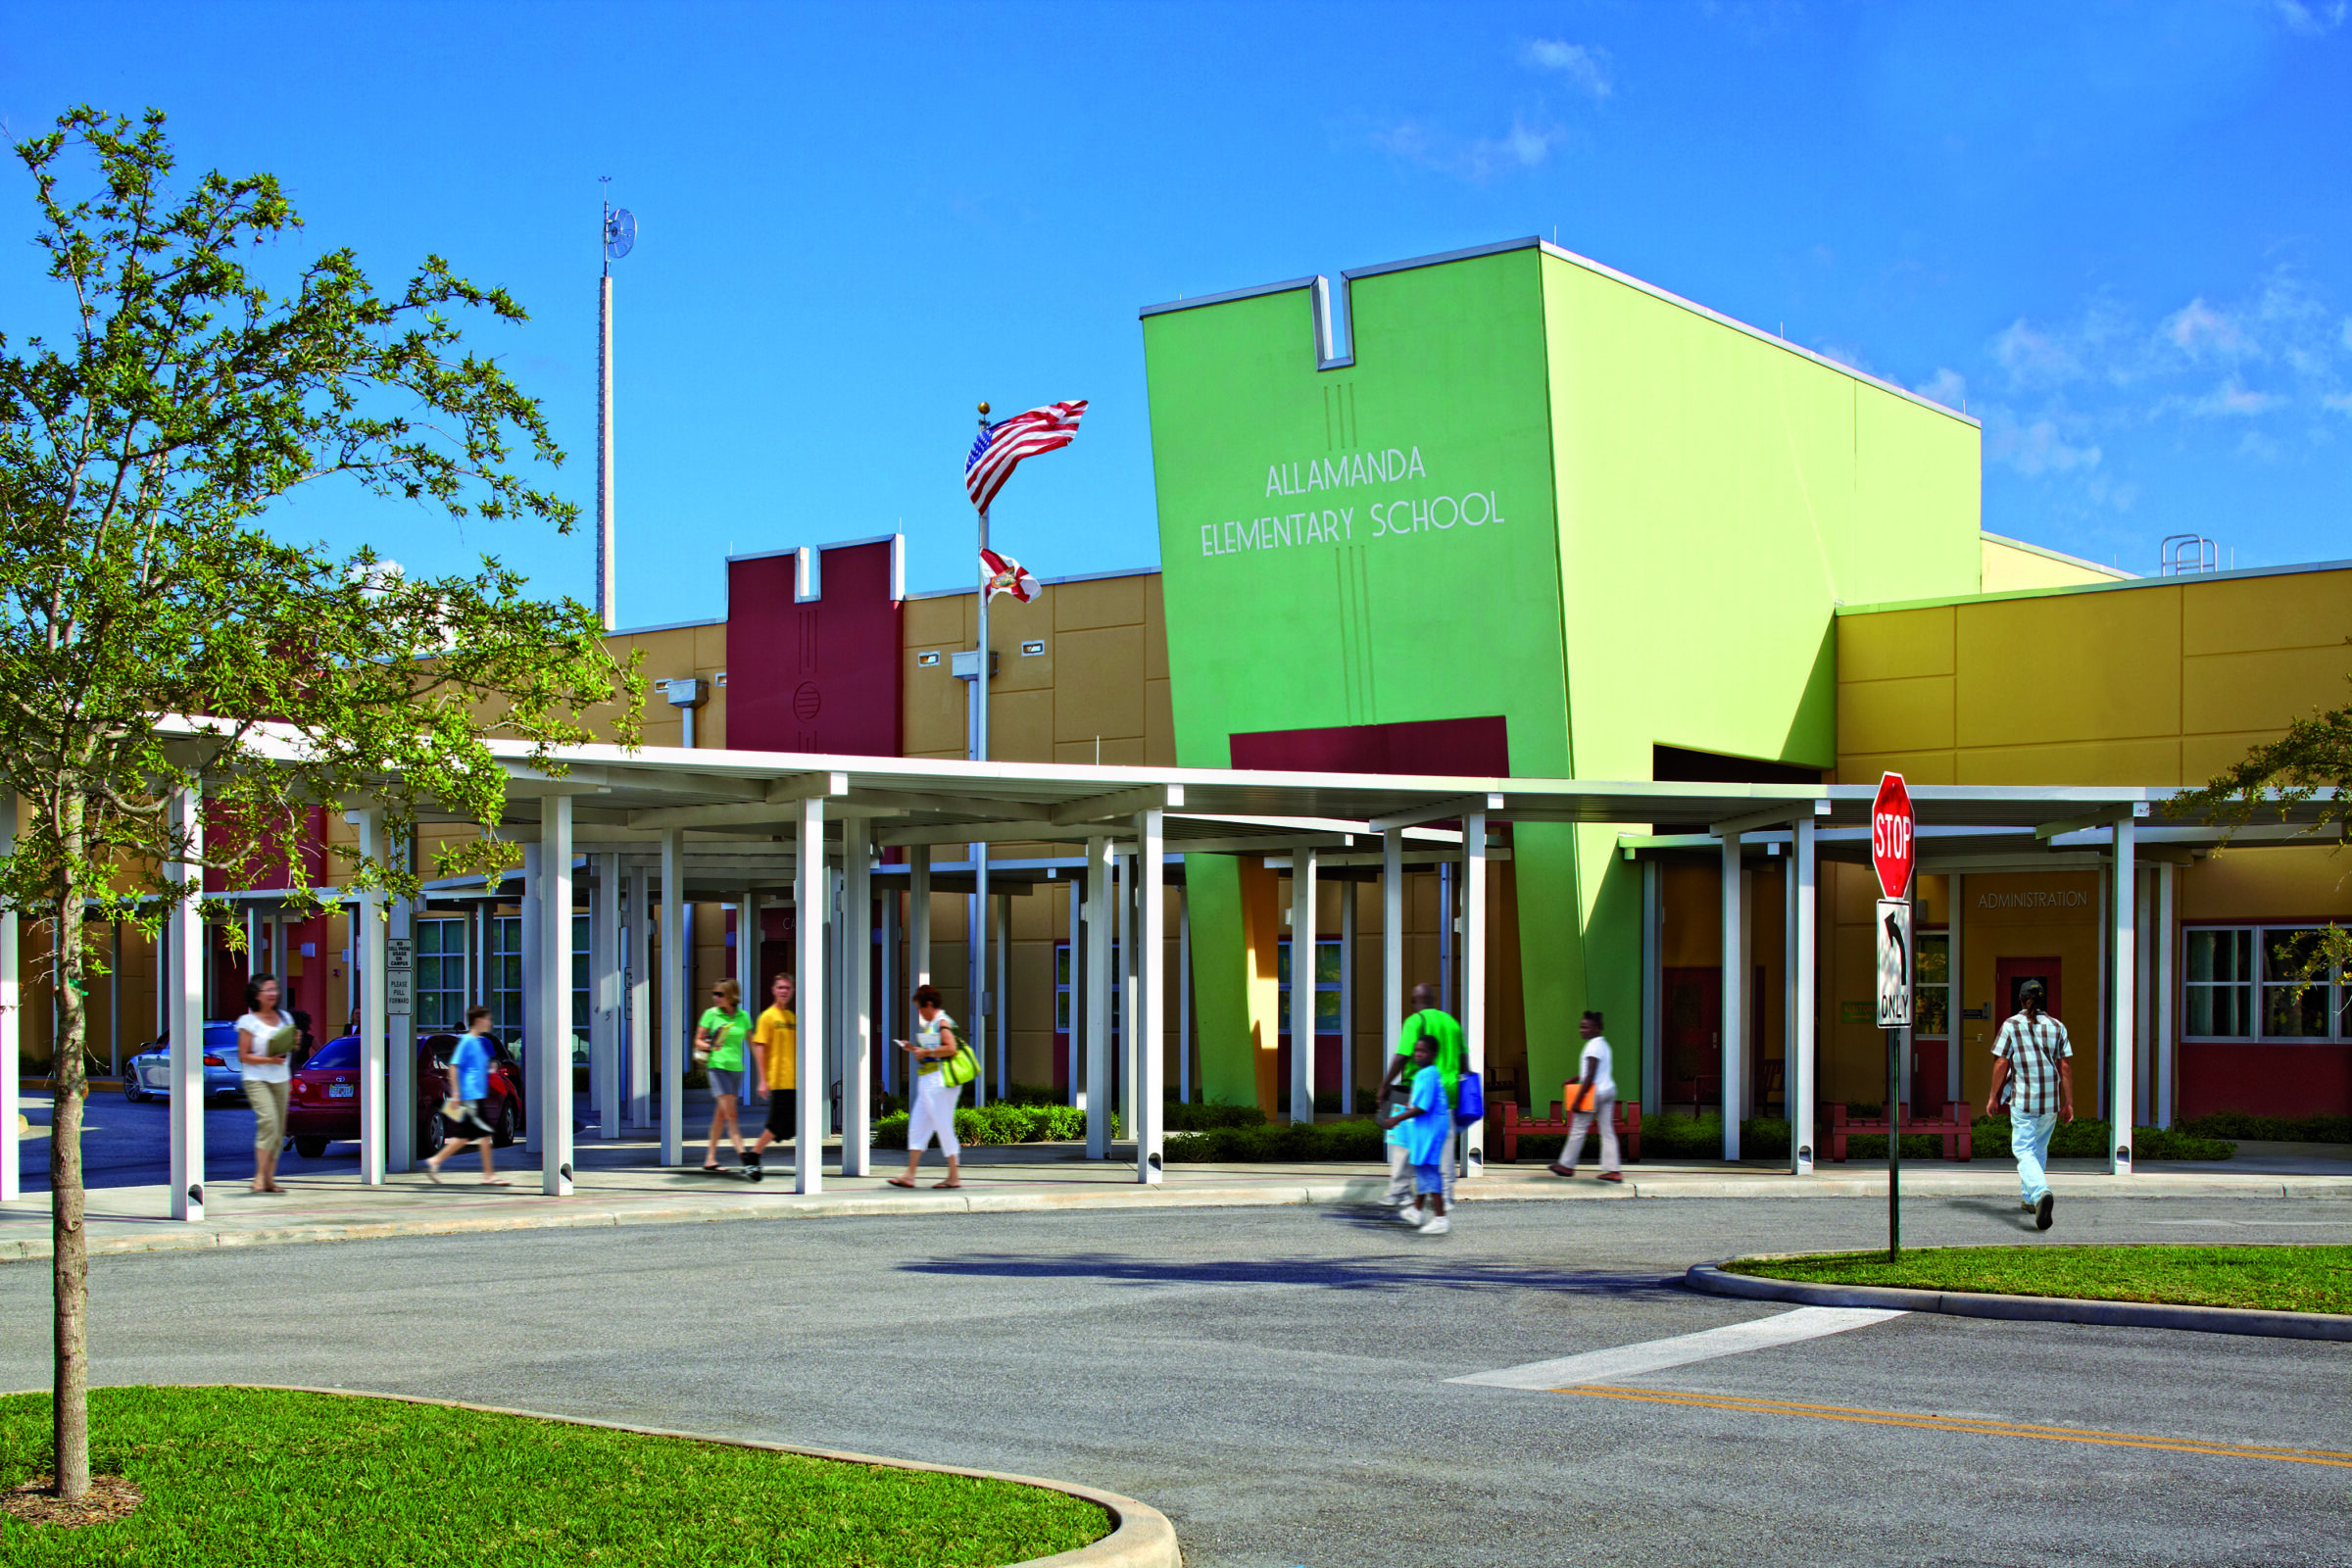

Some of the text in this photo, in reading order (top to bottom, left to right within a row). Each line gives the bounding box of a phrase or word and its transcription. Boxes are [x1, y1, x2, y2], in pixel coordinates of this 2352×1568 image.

[1266, 445, 1427, 498] ALLAMANDA
[1200, 490, 1505, 557] ELEMENTARY SCHOOL
[1876, 812, 1912, 859] STOP
[1978, 891, 2087, 909] ADMINISTRATION
[1882, 994, 1909, 1019] ONLY
